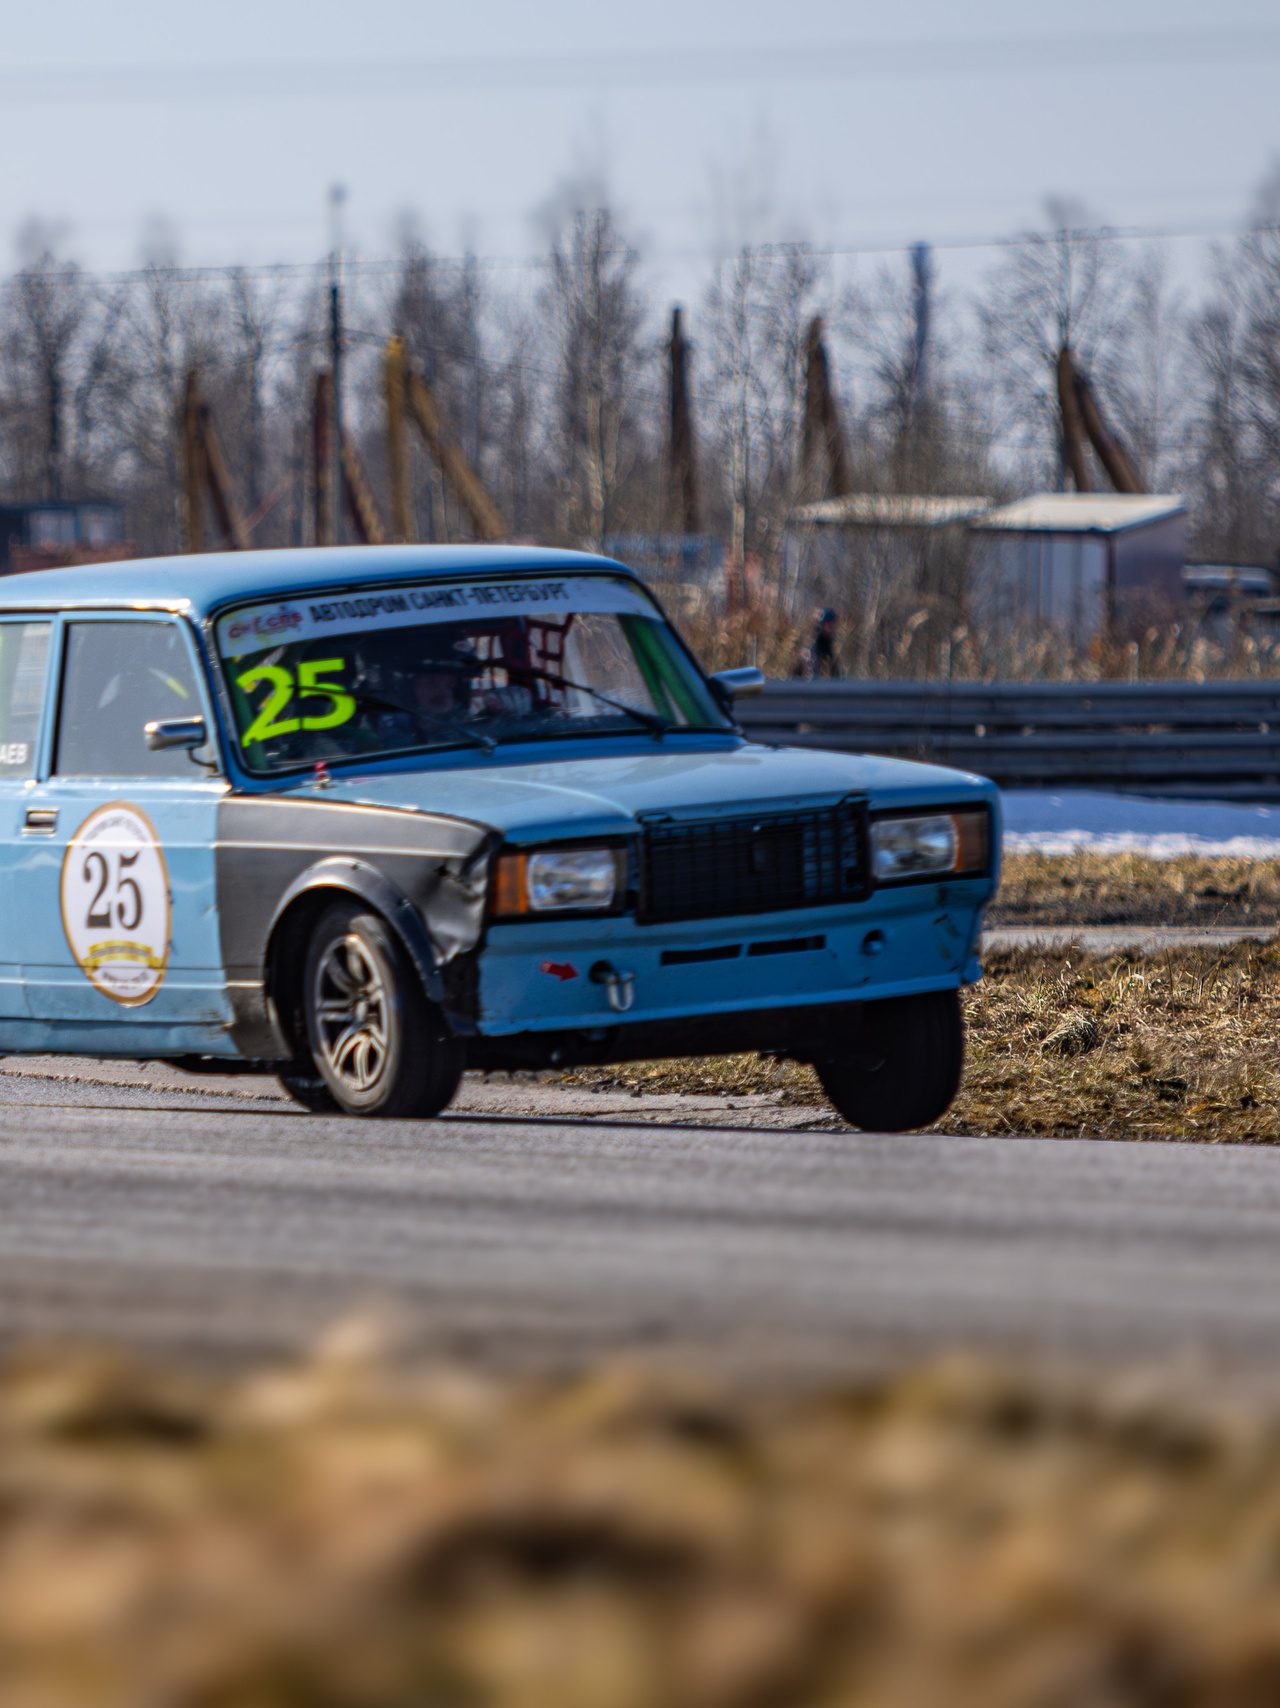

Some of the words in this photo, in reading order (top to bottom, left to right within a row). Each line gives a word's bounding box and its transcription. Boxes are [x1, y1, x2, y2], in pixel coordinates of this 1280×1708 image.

[309, 596, 410, 622] АВТОДРОМ
[409, 583, 570, 610] САНКТ-ПЕТЕРБУРГ
[235, 658, 357, 748] 25
[83, 851, 144, 931] 25
